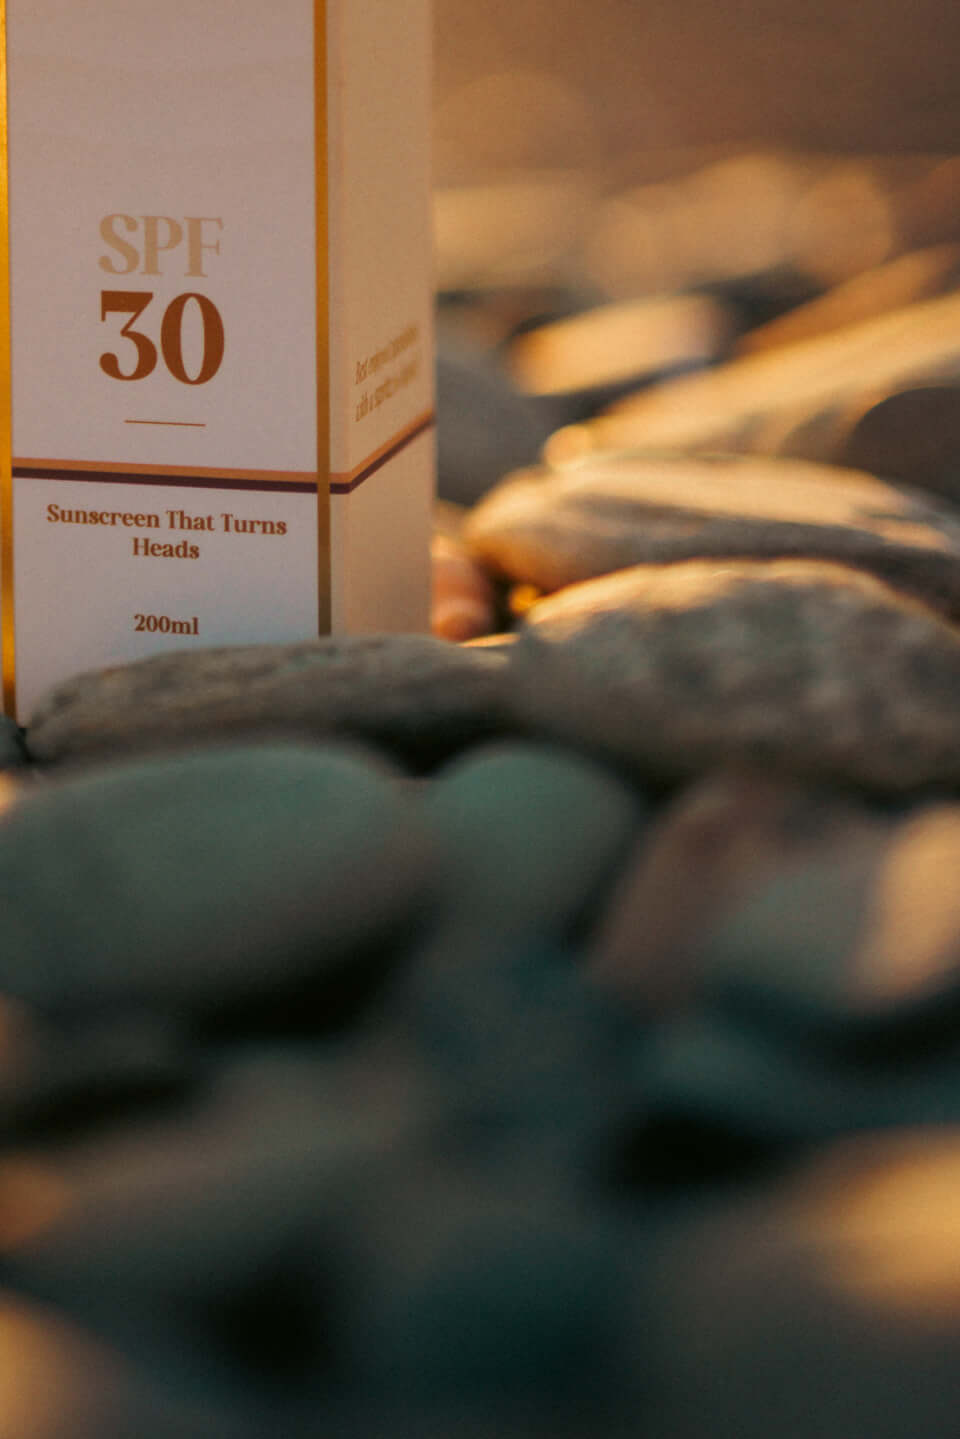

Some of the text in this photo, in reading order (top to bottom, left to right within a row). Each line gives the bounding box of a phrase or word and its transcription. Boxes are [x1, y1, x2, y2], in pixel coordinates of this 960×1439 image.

[98, 213, 224, 278] SPF
[99, 290, 225, 385] 30
[46, 503, 288, 536] Sunscreen That Turns
[132, 537, 200, 560] Heads
[134, 614, 199, 635] 200ml
